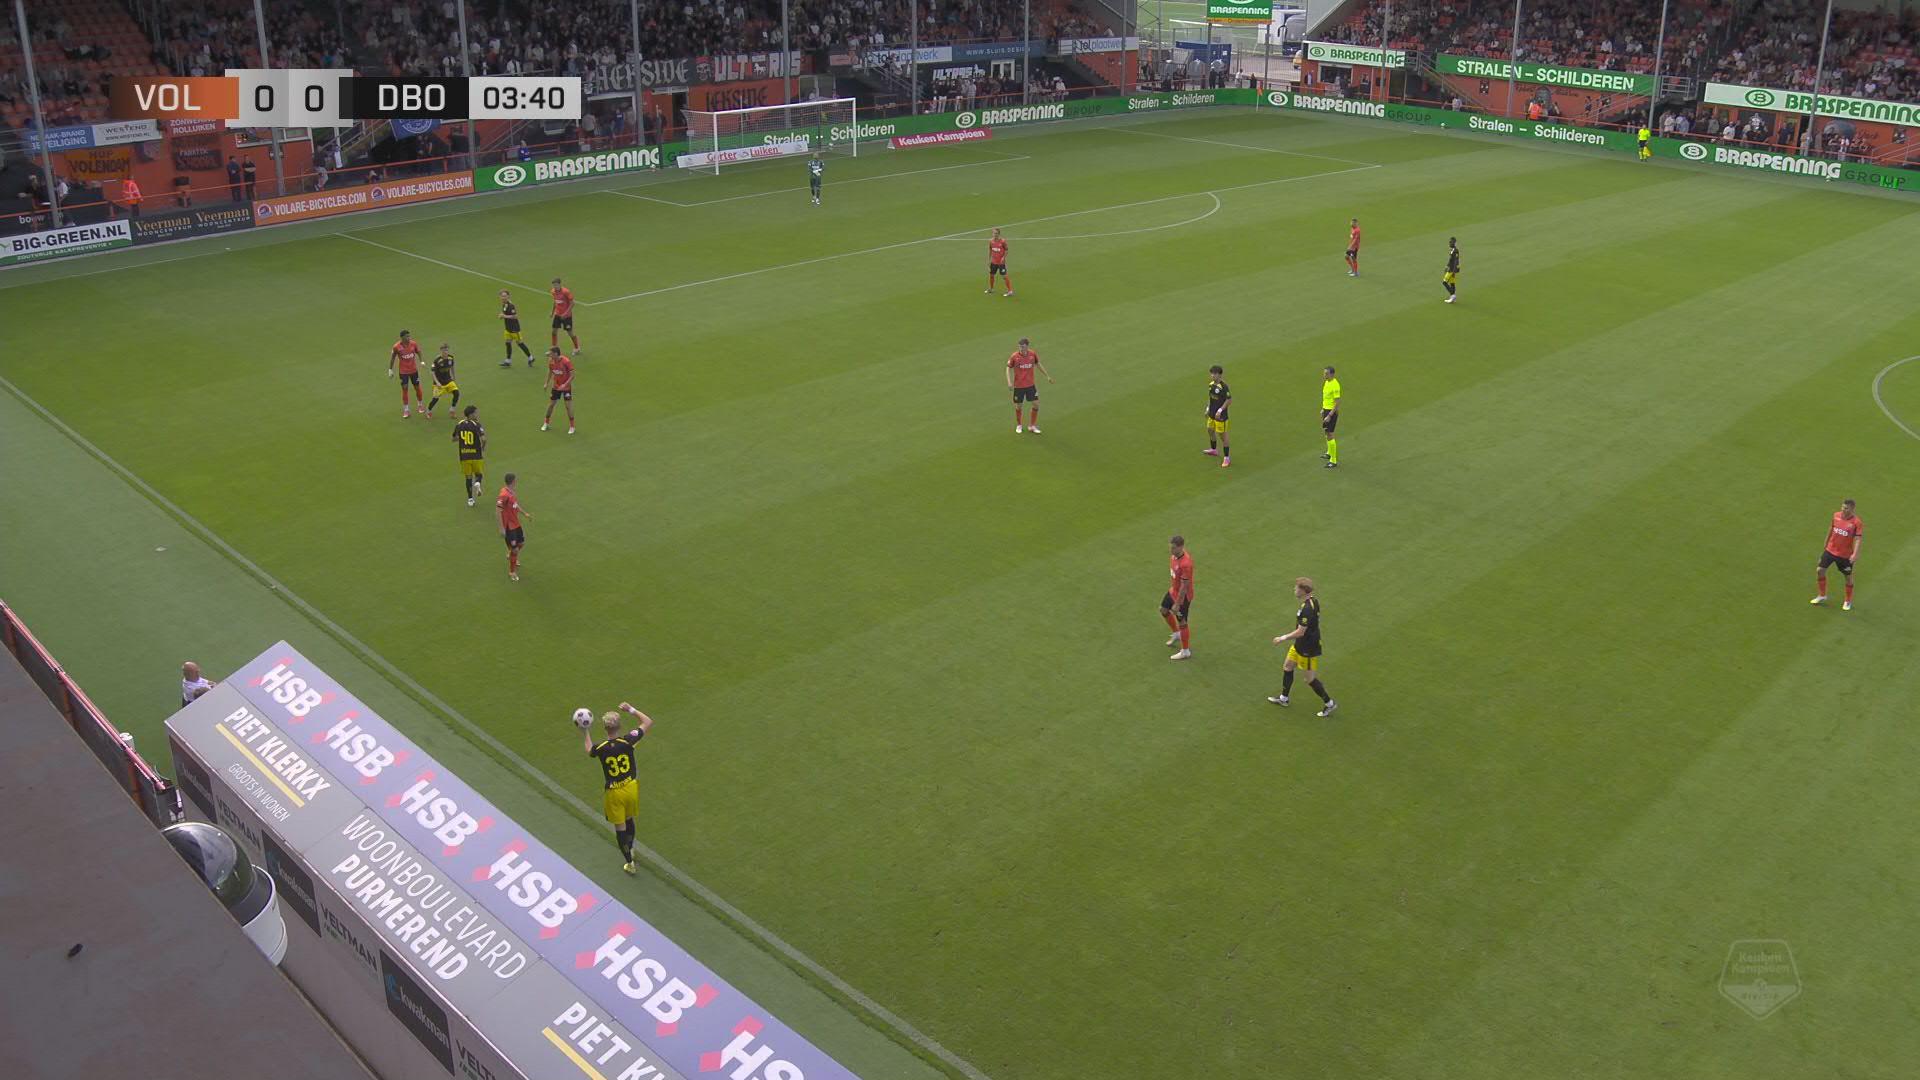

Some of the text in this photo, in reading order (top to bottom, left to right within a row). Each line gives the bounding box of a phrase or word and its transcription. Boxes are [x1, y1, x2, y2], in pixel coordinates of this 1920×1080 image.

[1210, 6, 1270, 15] BRASPENNING
[1457, 60, 1522, 79] STRALEN
[1537, 68, 1635, 91] SCHILDEREN
[981, 104, 1064, 126] BRASPENNING
[1128, 97, 1159, 110] Stralen
[1172, 93, 1215, 106] Schilderen
[1293, 95, 1385, 118] BRASPENNING
[1388, 109, 1431, 122] GROUP
[830, 122, 896, 142] Schilderen
[898, 128, 985, 147] Keuken Kampioen
[1469, 116, 1513, 133] Stralen
[1535, 124, 1605, 145] Schilderen
[535, 147, 660, 182] BRASPENNING
[1715, 147, 1842, 179] BRASPENNING
[1845, 169, 1906, 187] GROUP
[386, 176, 472, 200] VOLARE-BICYCLES.COM
[196, 208, 250, 223] Veerman
[274, 191, 367, 216] VOLARE-BICYCLES.COM
[12, 224, 128, 252] BIG-GREEN.NL
[135, 216, 192, 233] Veerman
[460, 430, 475, 446] 40
[259, 663, 323, 718] HSB
[223, 706, 272, 744] PIET
[256, 736, 331, 801] KLERKX
[325, 717, 396, 778] HSB
[605, 754, 631, 777] 33
[260, 795, 291, 823] WONEN
[399, 778, 480, 847] HSB
[341, 813, 528, 980] WOONBOULEVARD
[487, 849, 578, 929] HSB
[331, 853, 470, 981] PURMEREND
[319, 903, 378, 973] VELTMAN
[592, 932, 697, 1024] HSB
[399, 985, 450, 1046] kwakman
[552, 1001, 632, 1066] PIET
